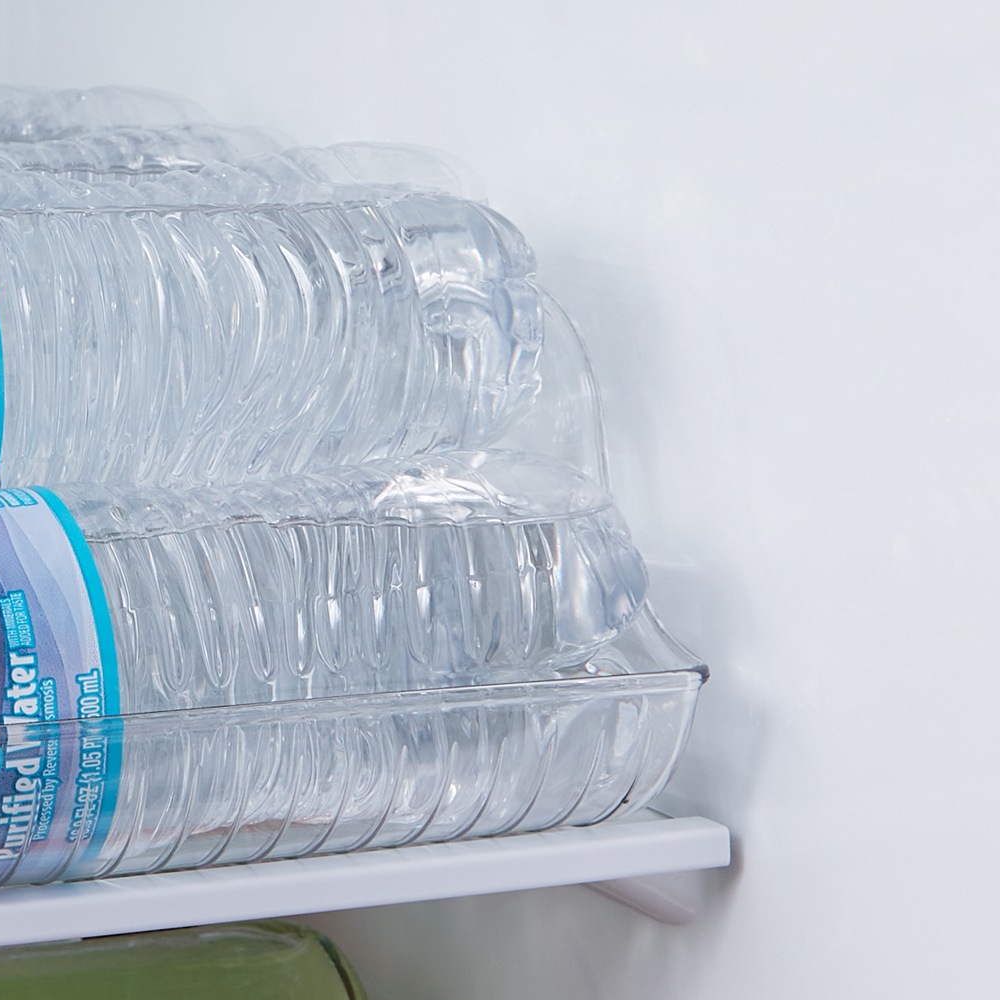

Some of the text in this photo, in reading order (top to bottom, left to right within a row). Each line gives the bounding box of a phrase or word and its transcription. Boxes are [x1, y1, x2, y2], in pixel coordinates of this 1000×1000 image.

[10, 592, 32, 646] ADDED FOR TASTE
[8, 629, 20, 648] WITH
[78, 671, 99, 693] mL
[32, 793, 55, 840] Processed
[45, 777, 59, 793] by
